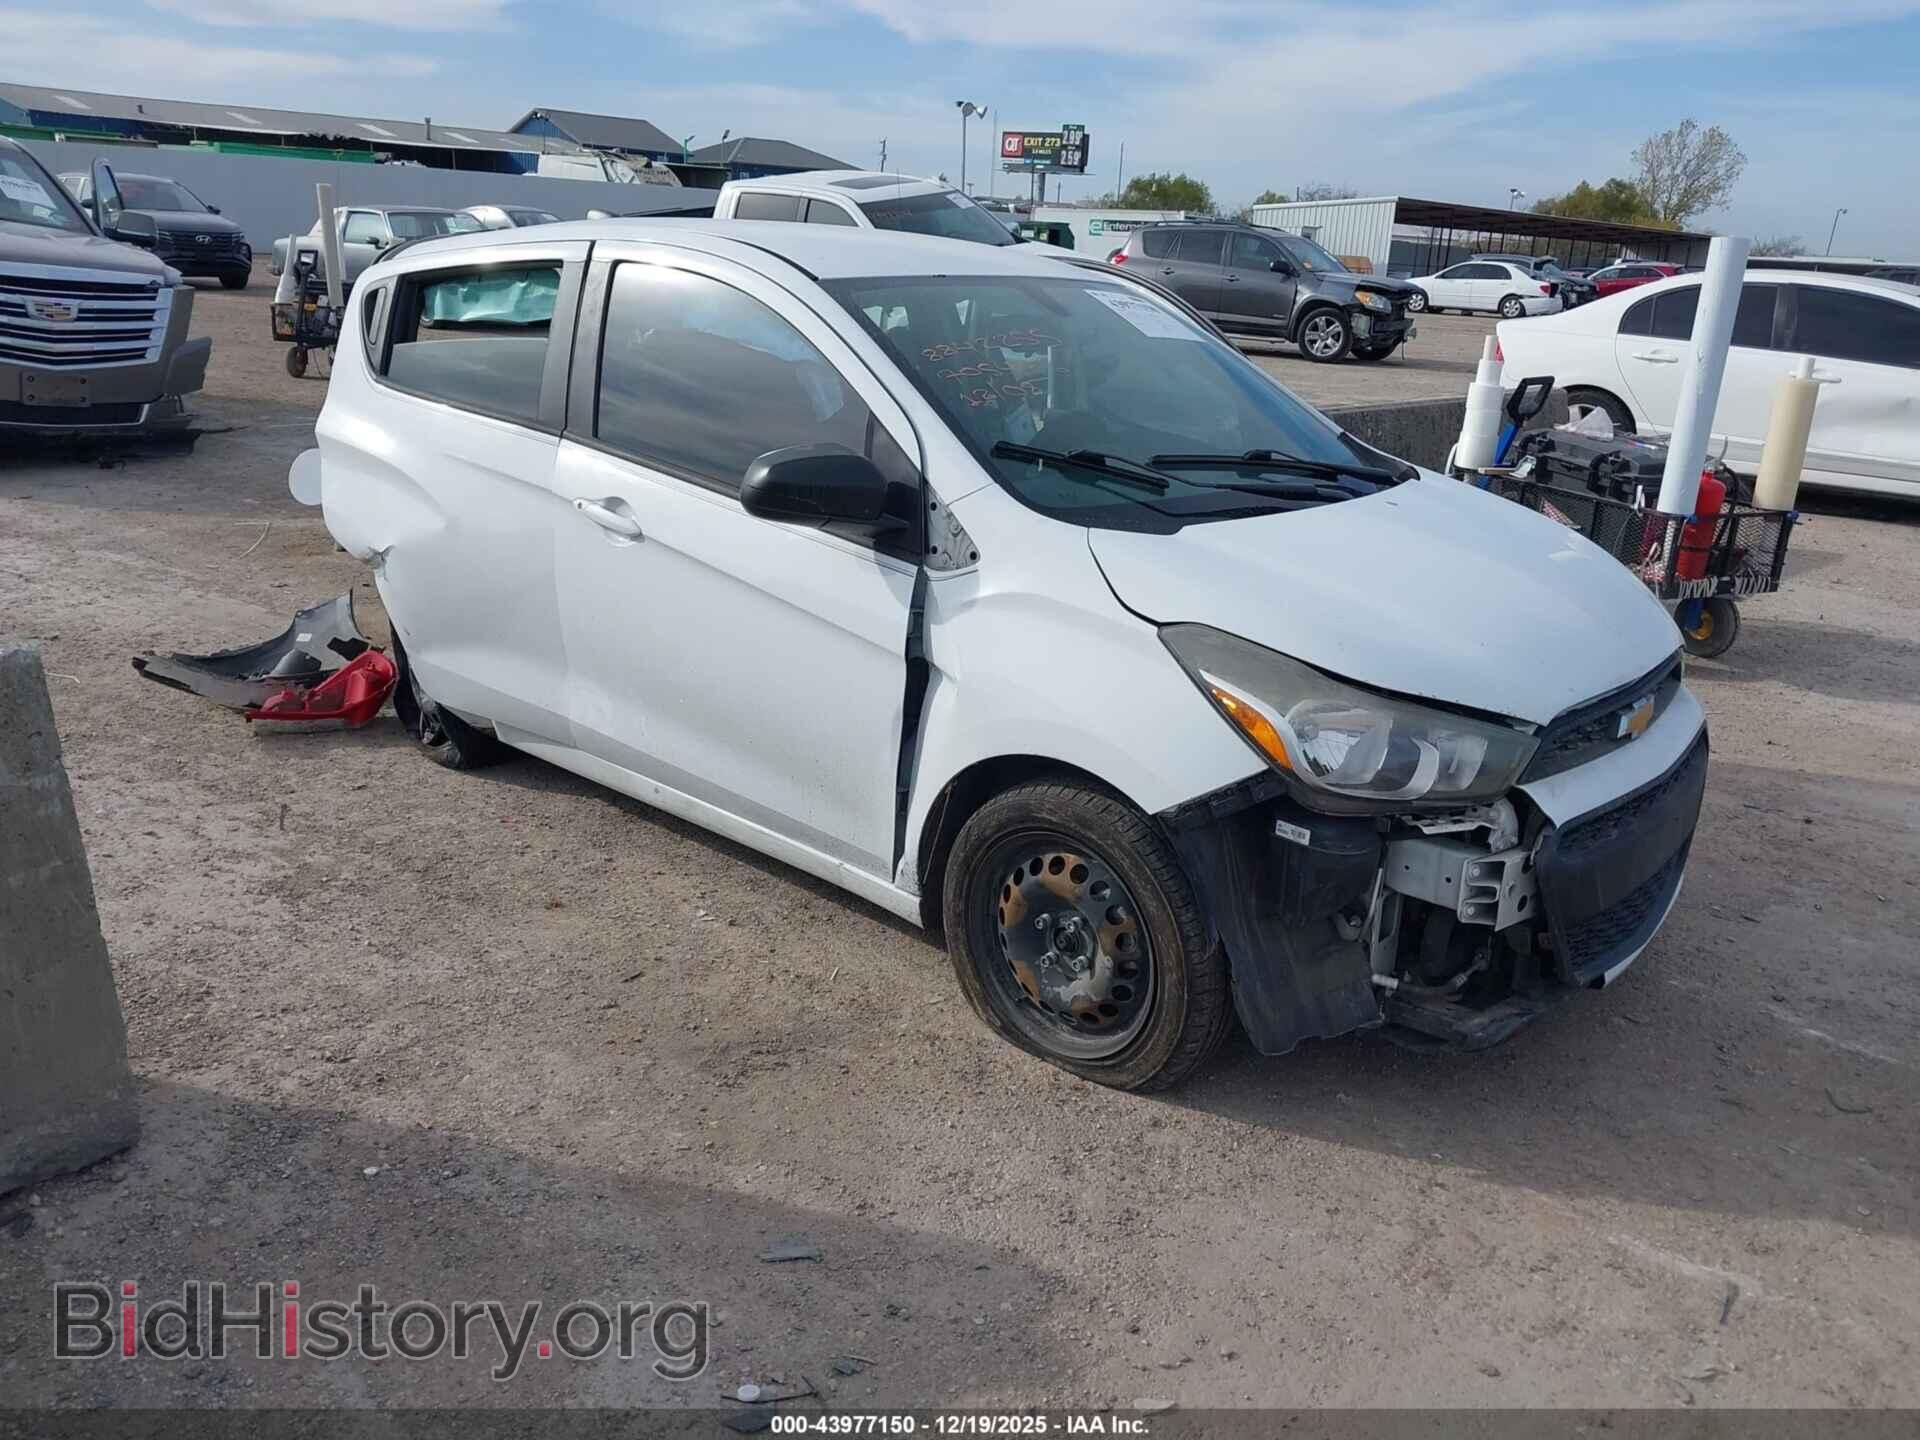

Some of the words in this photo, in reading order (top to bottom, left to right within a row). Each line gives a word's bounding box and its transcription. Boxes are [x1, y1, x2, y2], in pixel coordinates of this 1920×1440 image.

[1005, 138, 1020, 152] QT
[1024, 137, 1043, 146] EXIT
[1044, 138, 1061, 147] 273
